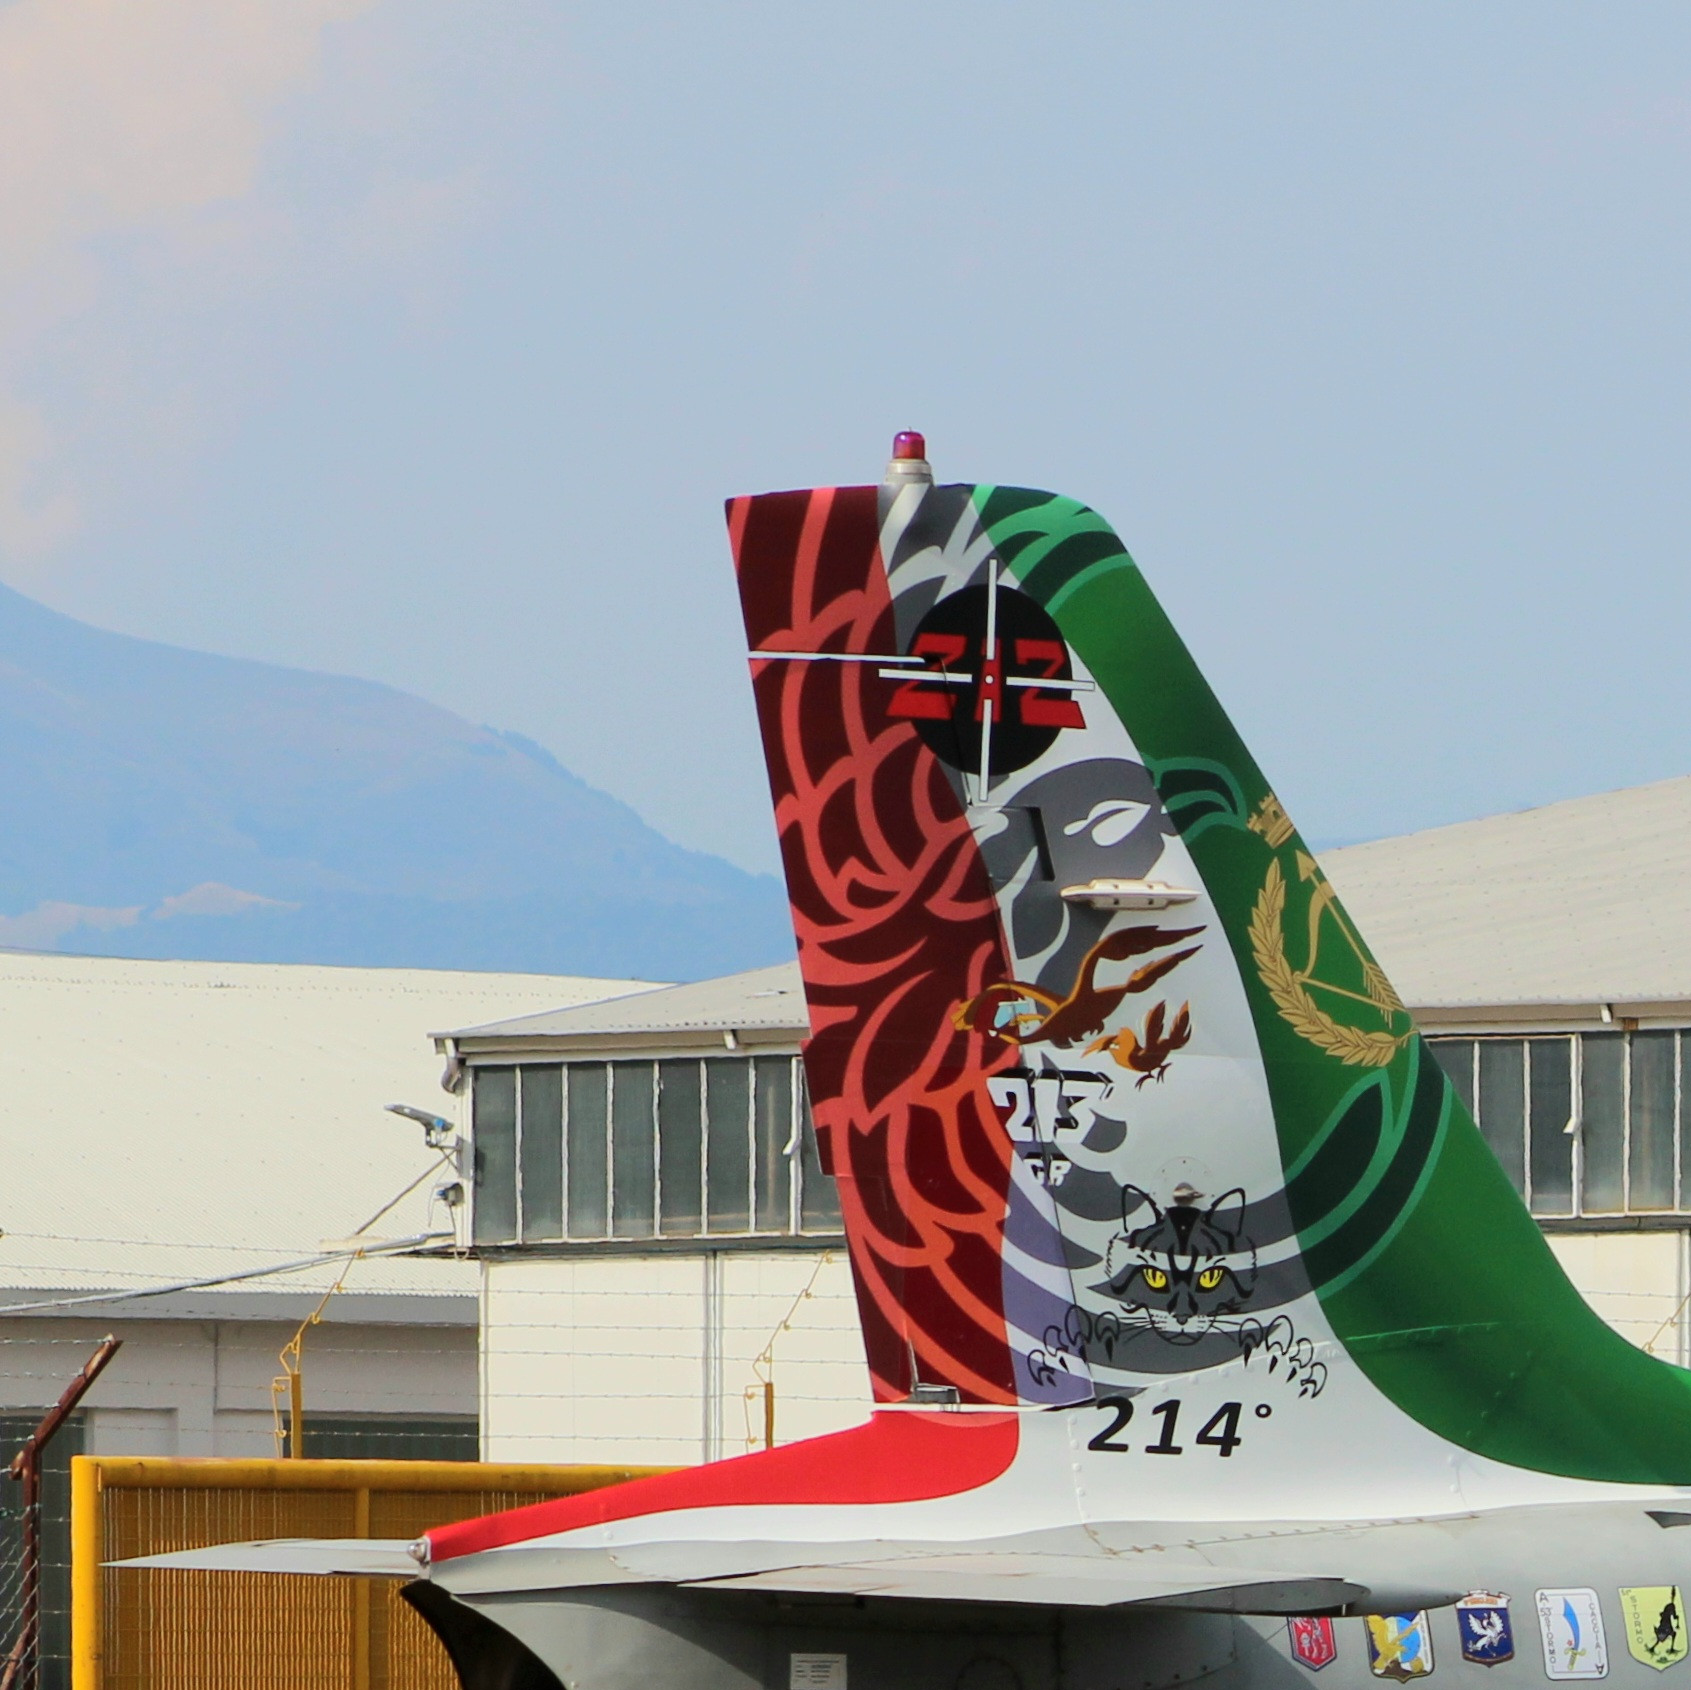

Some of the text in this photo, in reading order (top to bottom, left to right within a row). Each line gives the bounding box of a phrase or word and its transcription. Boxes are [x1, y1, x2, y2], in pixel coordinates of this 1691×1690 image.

[986, 1068, 1110, 1144] 213
[1544, 1616, 1557, 1664] STORMO
[1588, 1602, 1602, 1650] CACCIA
[1630, 1595, 1644, 1644] STORMO
